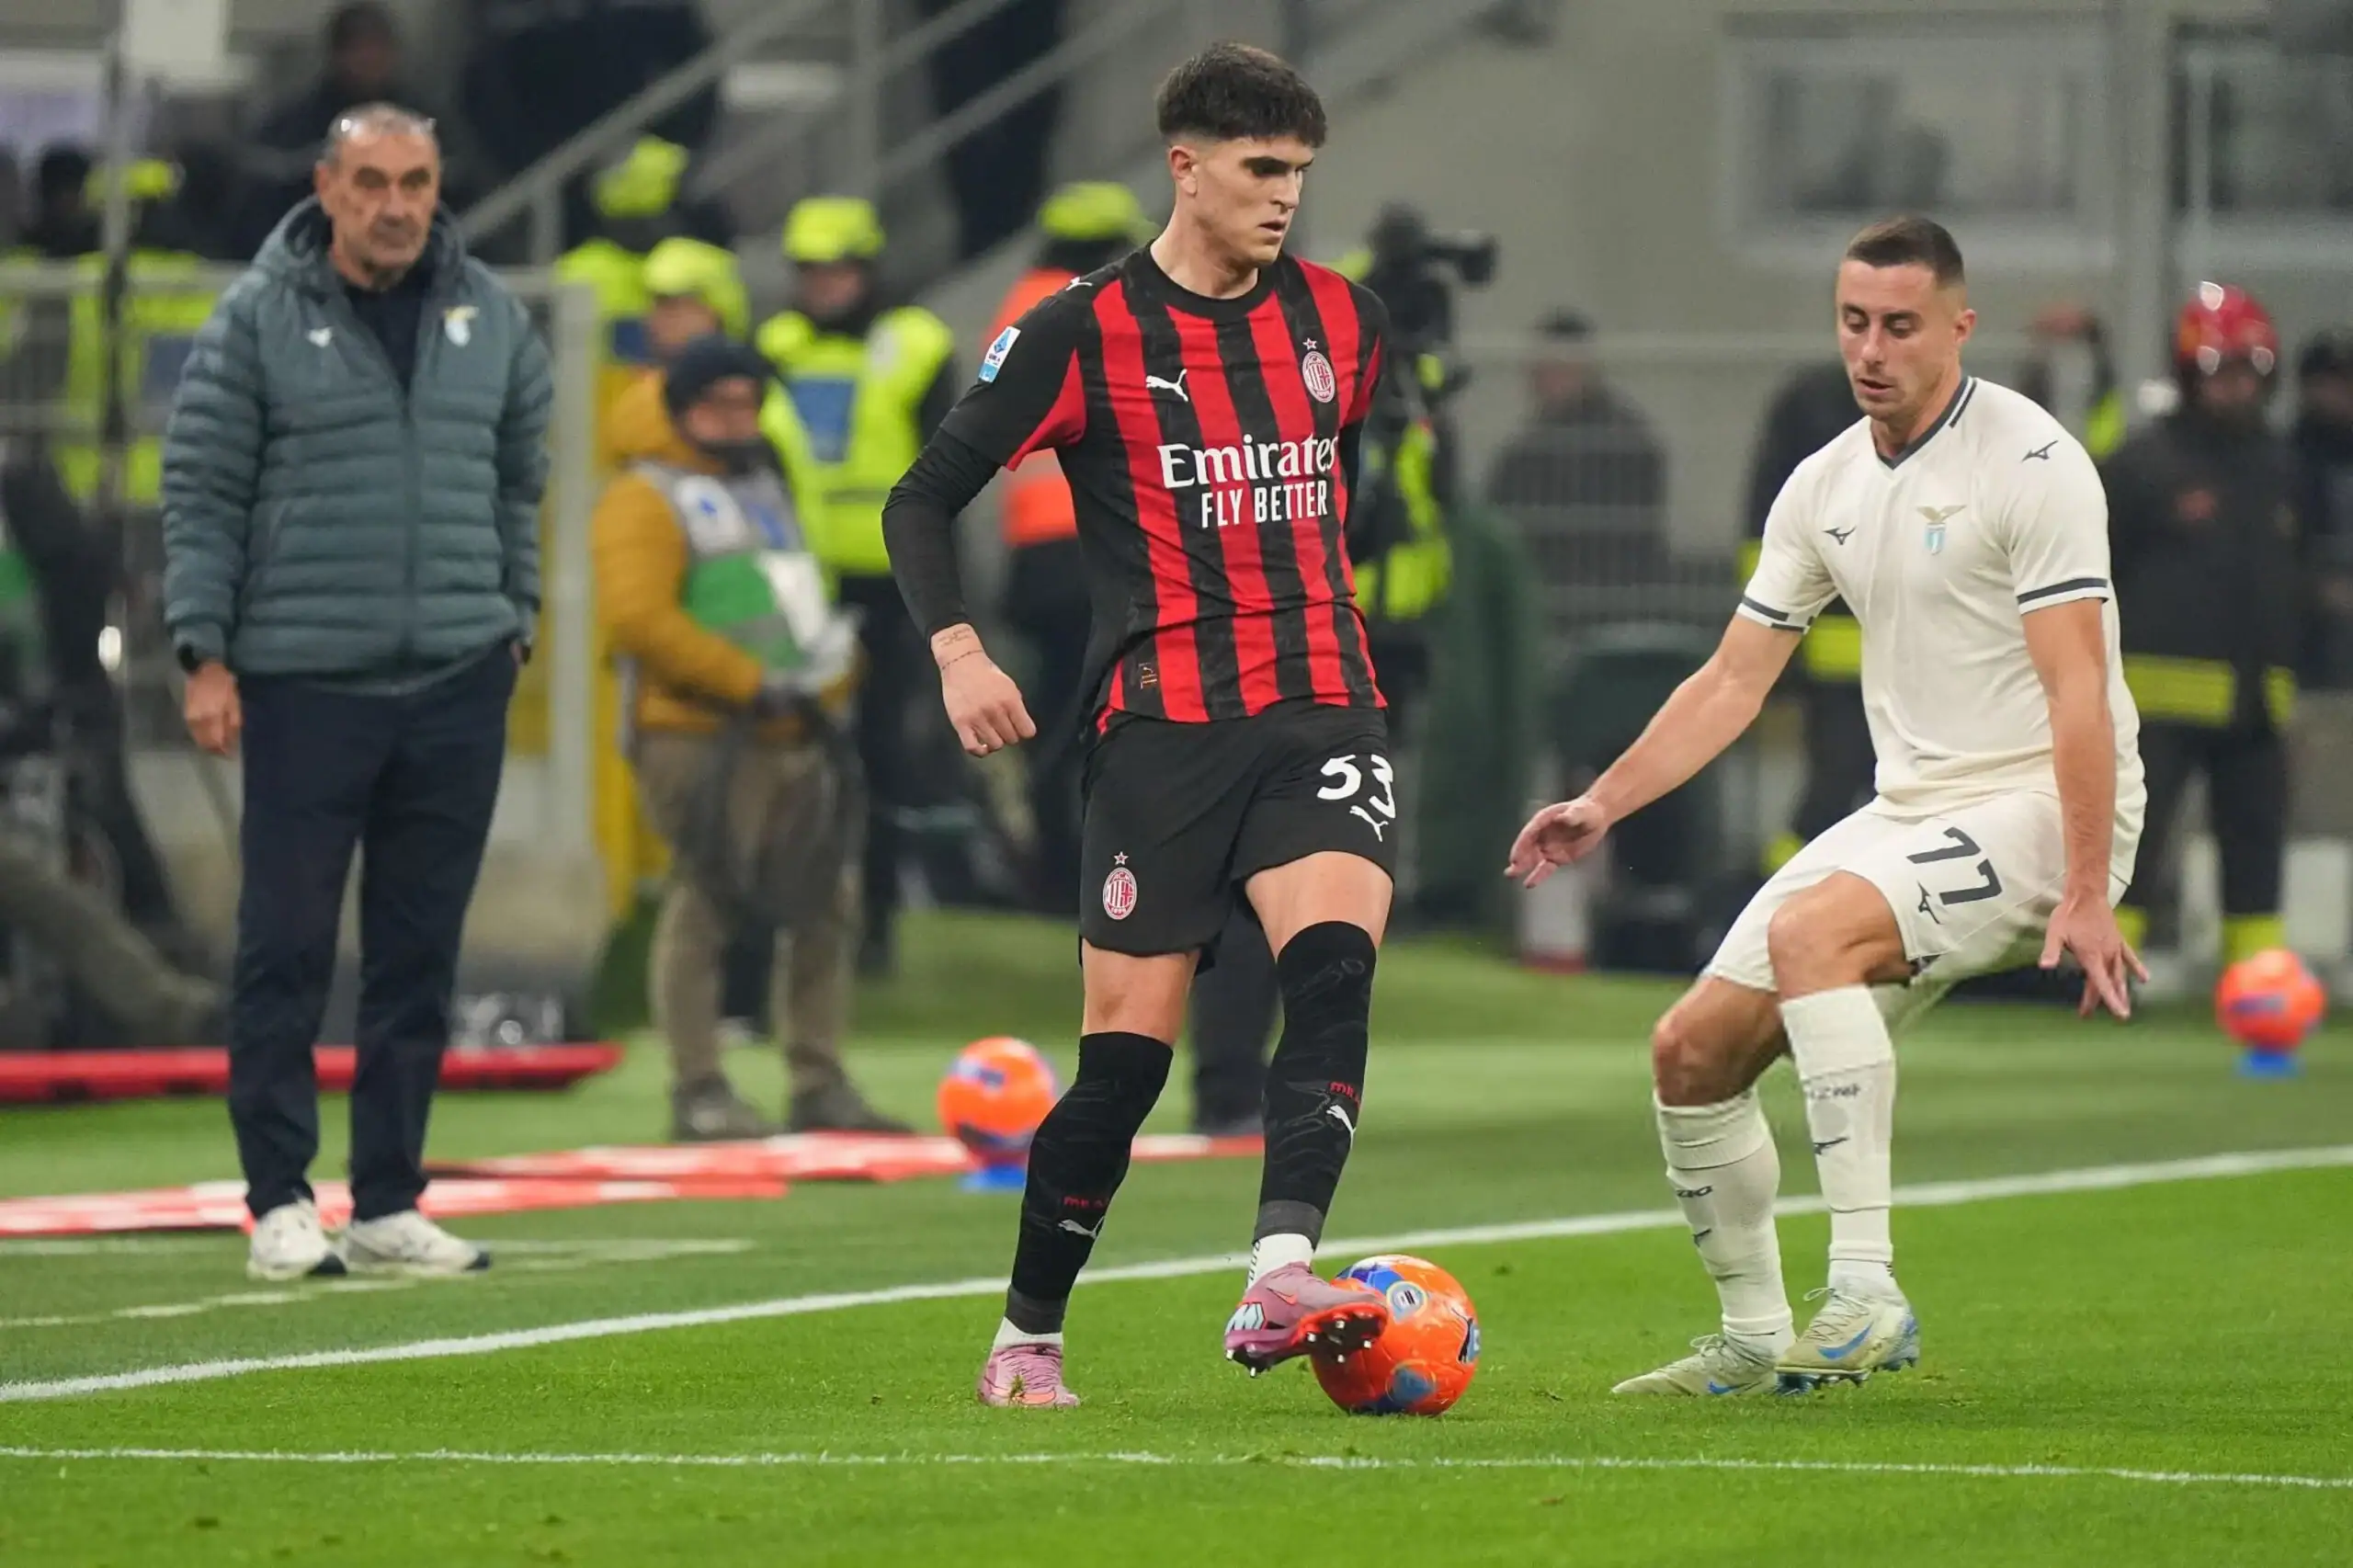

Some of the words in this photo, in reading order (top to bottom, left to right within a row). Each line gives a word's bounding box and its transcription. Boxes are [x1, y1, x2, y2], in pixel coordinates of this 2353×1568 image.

[1157, 433, 1338, 489] Emirates
[1201, 488, 1243, 528] FLY
[1254, 480, 1328, 523] BETTER
[1316, 754, 1396, 819] 53
[1905, 826, 2003, 906] 77
